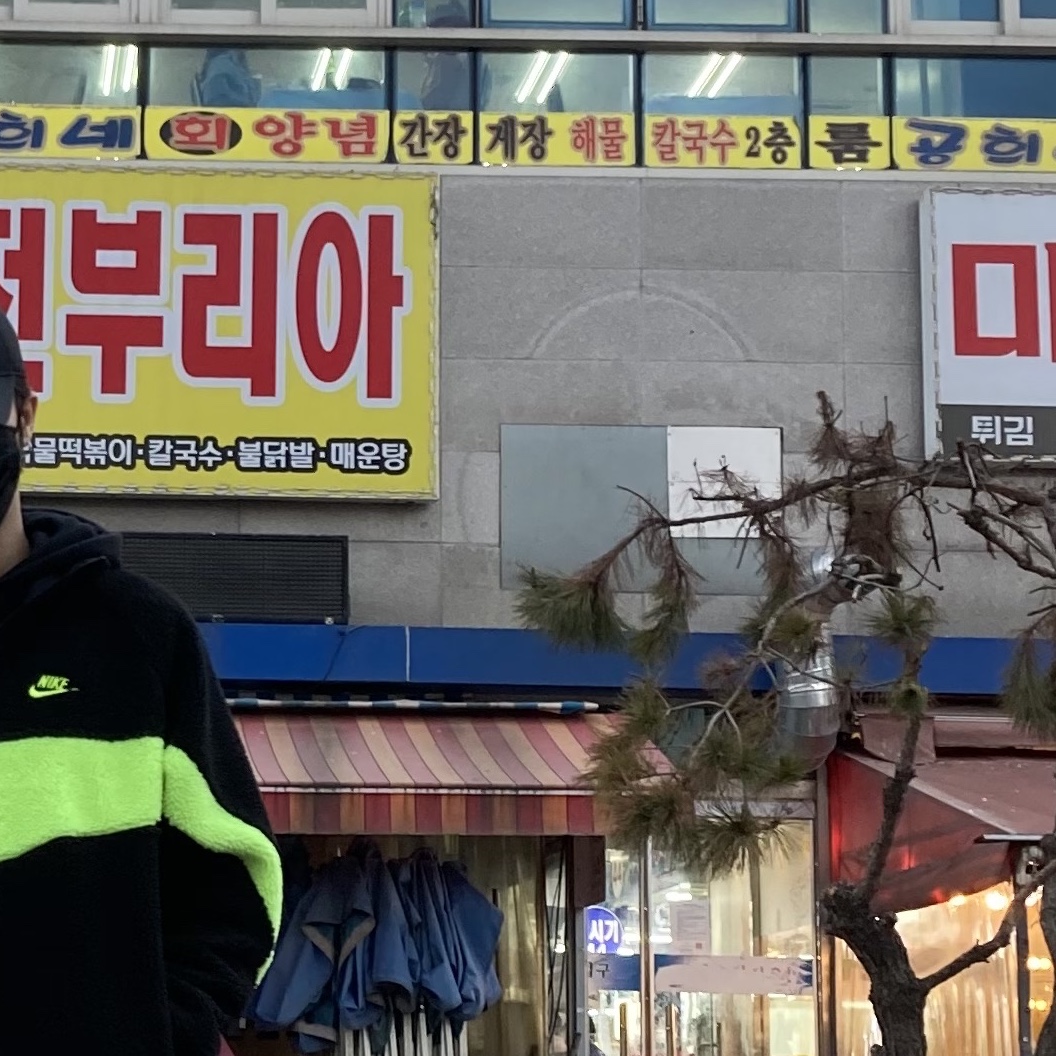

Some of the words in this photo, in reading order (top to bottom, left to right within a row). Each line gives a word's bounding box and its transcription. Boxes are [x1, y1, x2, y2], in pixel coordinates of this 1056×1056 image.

[172, 114, 232, 152] 회
[253, 111, 377, 157] 양념
[400, 113, 470, 159] 간장
[486, 115, 553, 161] 게장
[570, 117, 628, 162] 해물
[653, 117, 740, 166] 칼국수
[745, 121, 796, 165] 2층
[815, 122, 883, 164] 룸
[36, 674, 70, 691] NIKE
